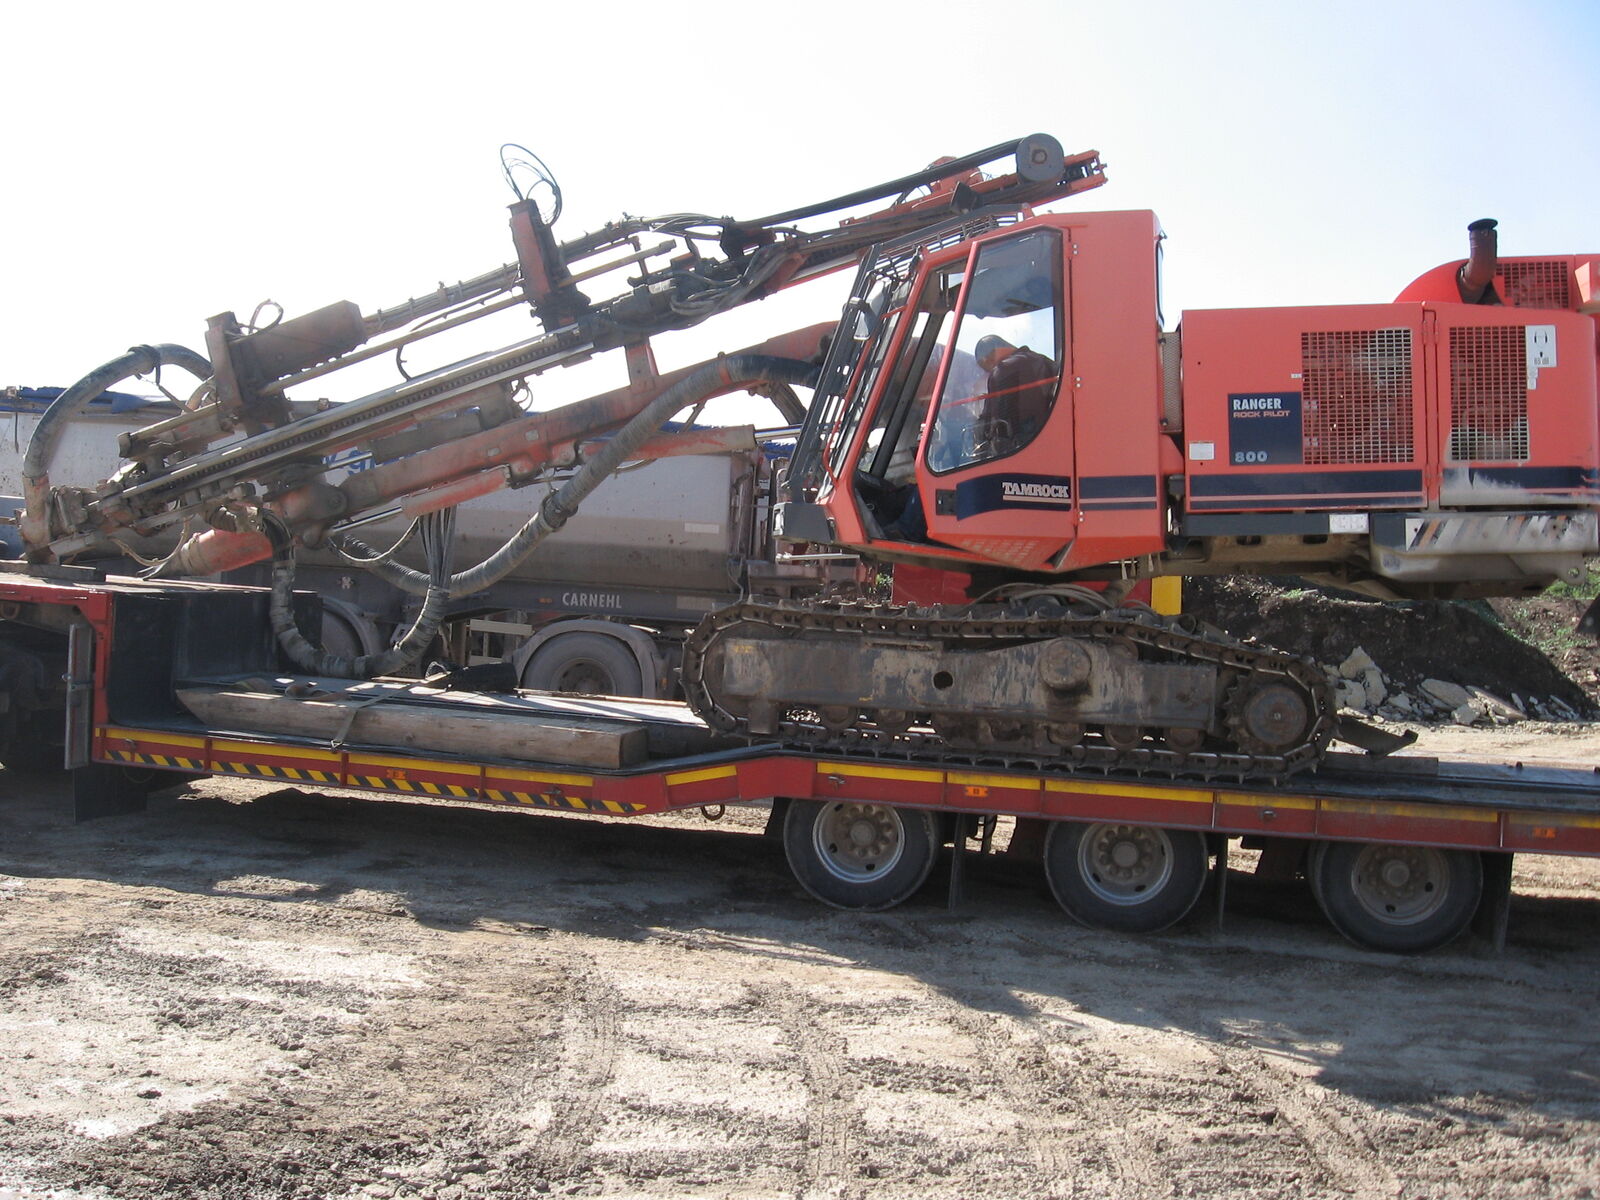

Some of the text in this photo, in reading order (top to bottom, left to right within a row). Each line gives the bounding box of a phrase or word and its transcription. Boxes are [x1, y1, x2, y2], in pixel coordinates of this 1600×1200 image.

[1233, 398, 1282, 411] RANGER
[1234, 451, 1268, 463] 800
[1002, 482, 1070, 498] TAMROCK
[562, 592, 622, 609] CARNEHL
